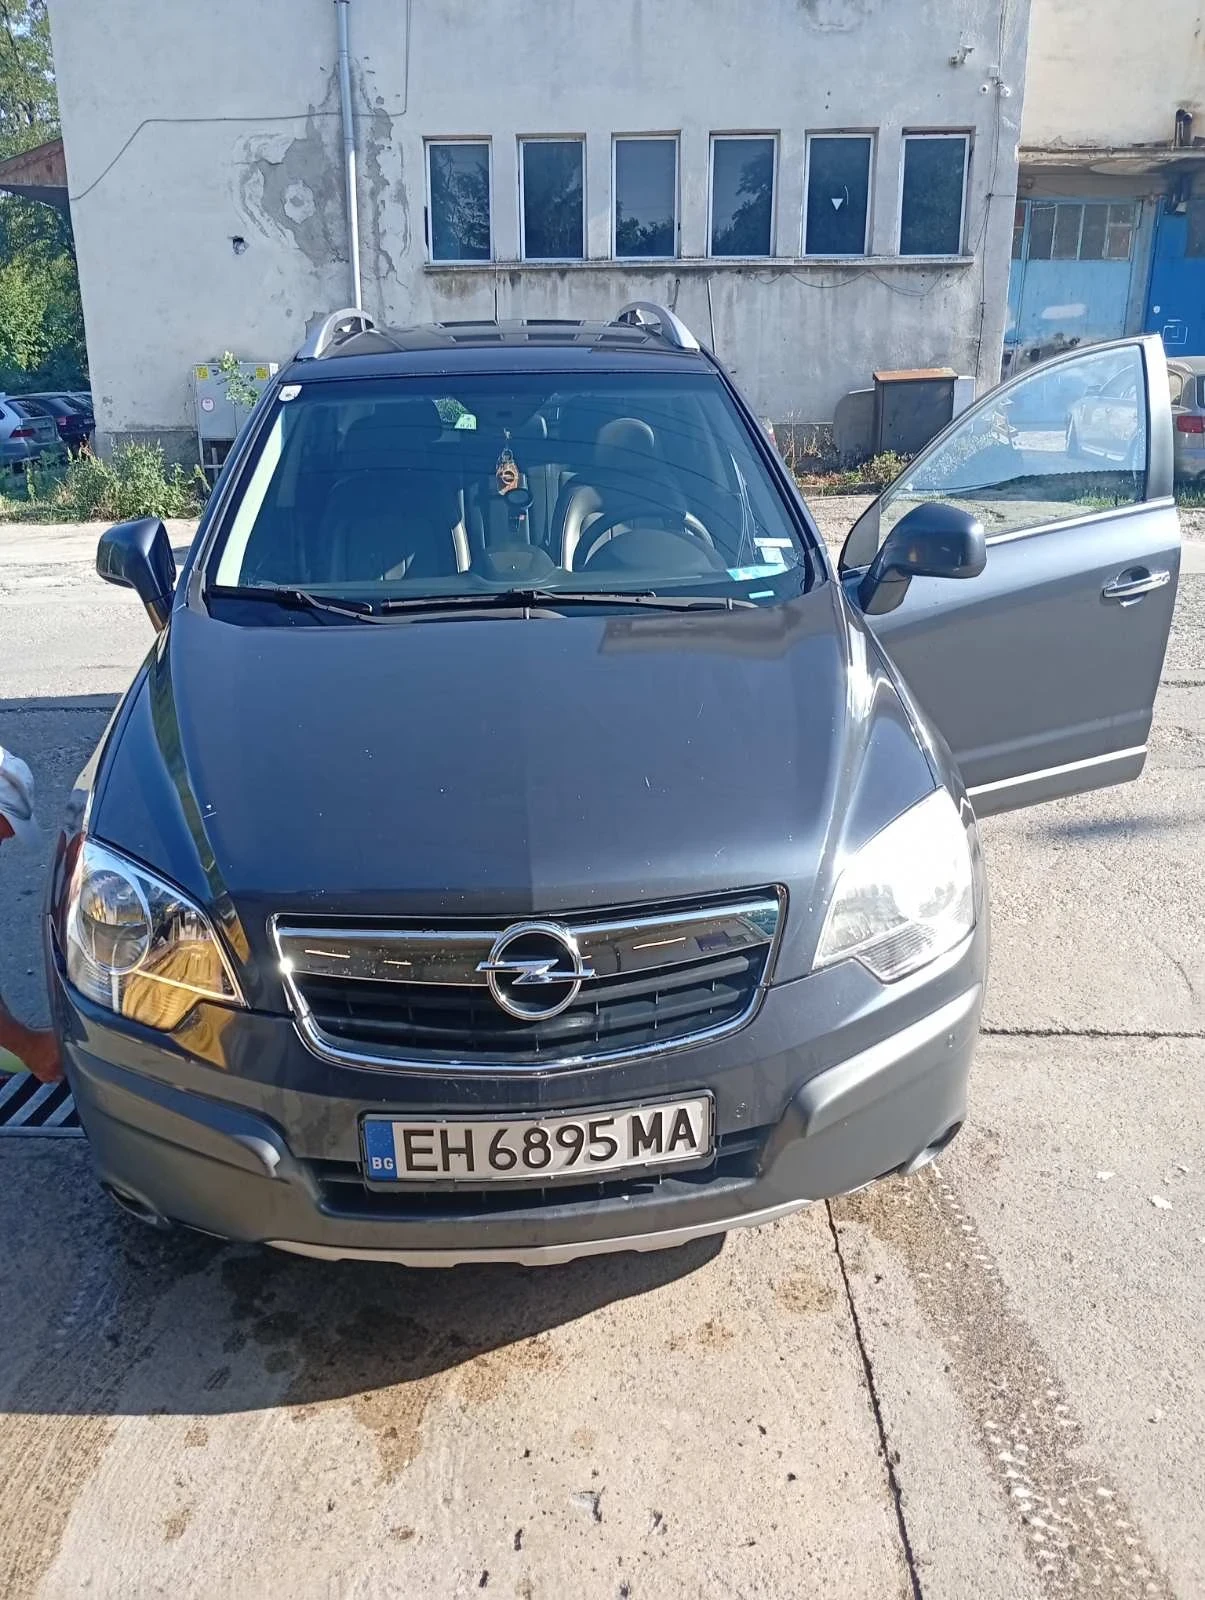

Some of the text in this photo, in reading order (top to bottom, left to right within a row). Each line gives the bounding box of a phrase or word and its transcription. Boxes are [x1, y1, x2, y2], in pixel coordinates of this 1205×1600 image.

[403, 1108, 697, 1172] EH 6895 MA
[372, 1157, 394, 1171] BG
